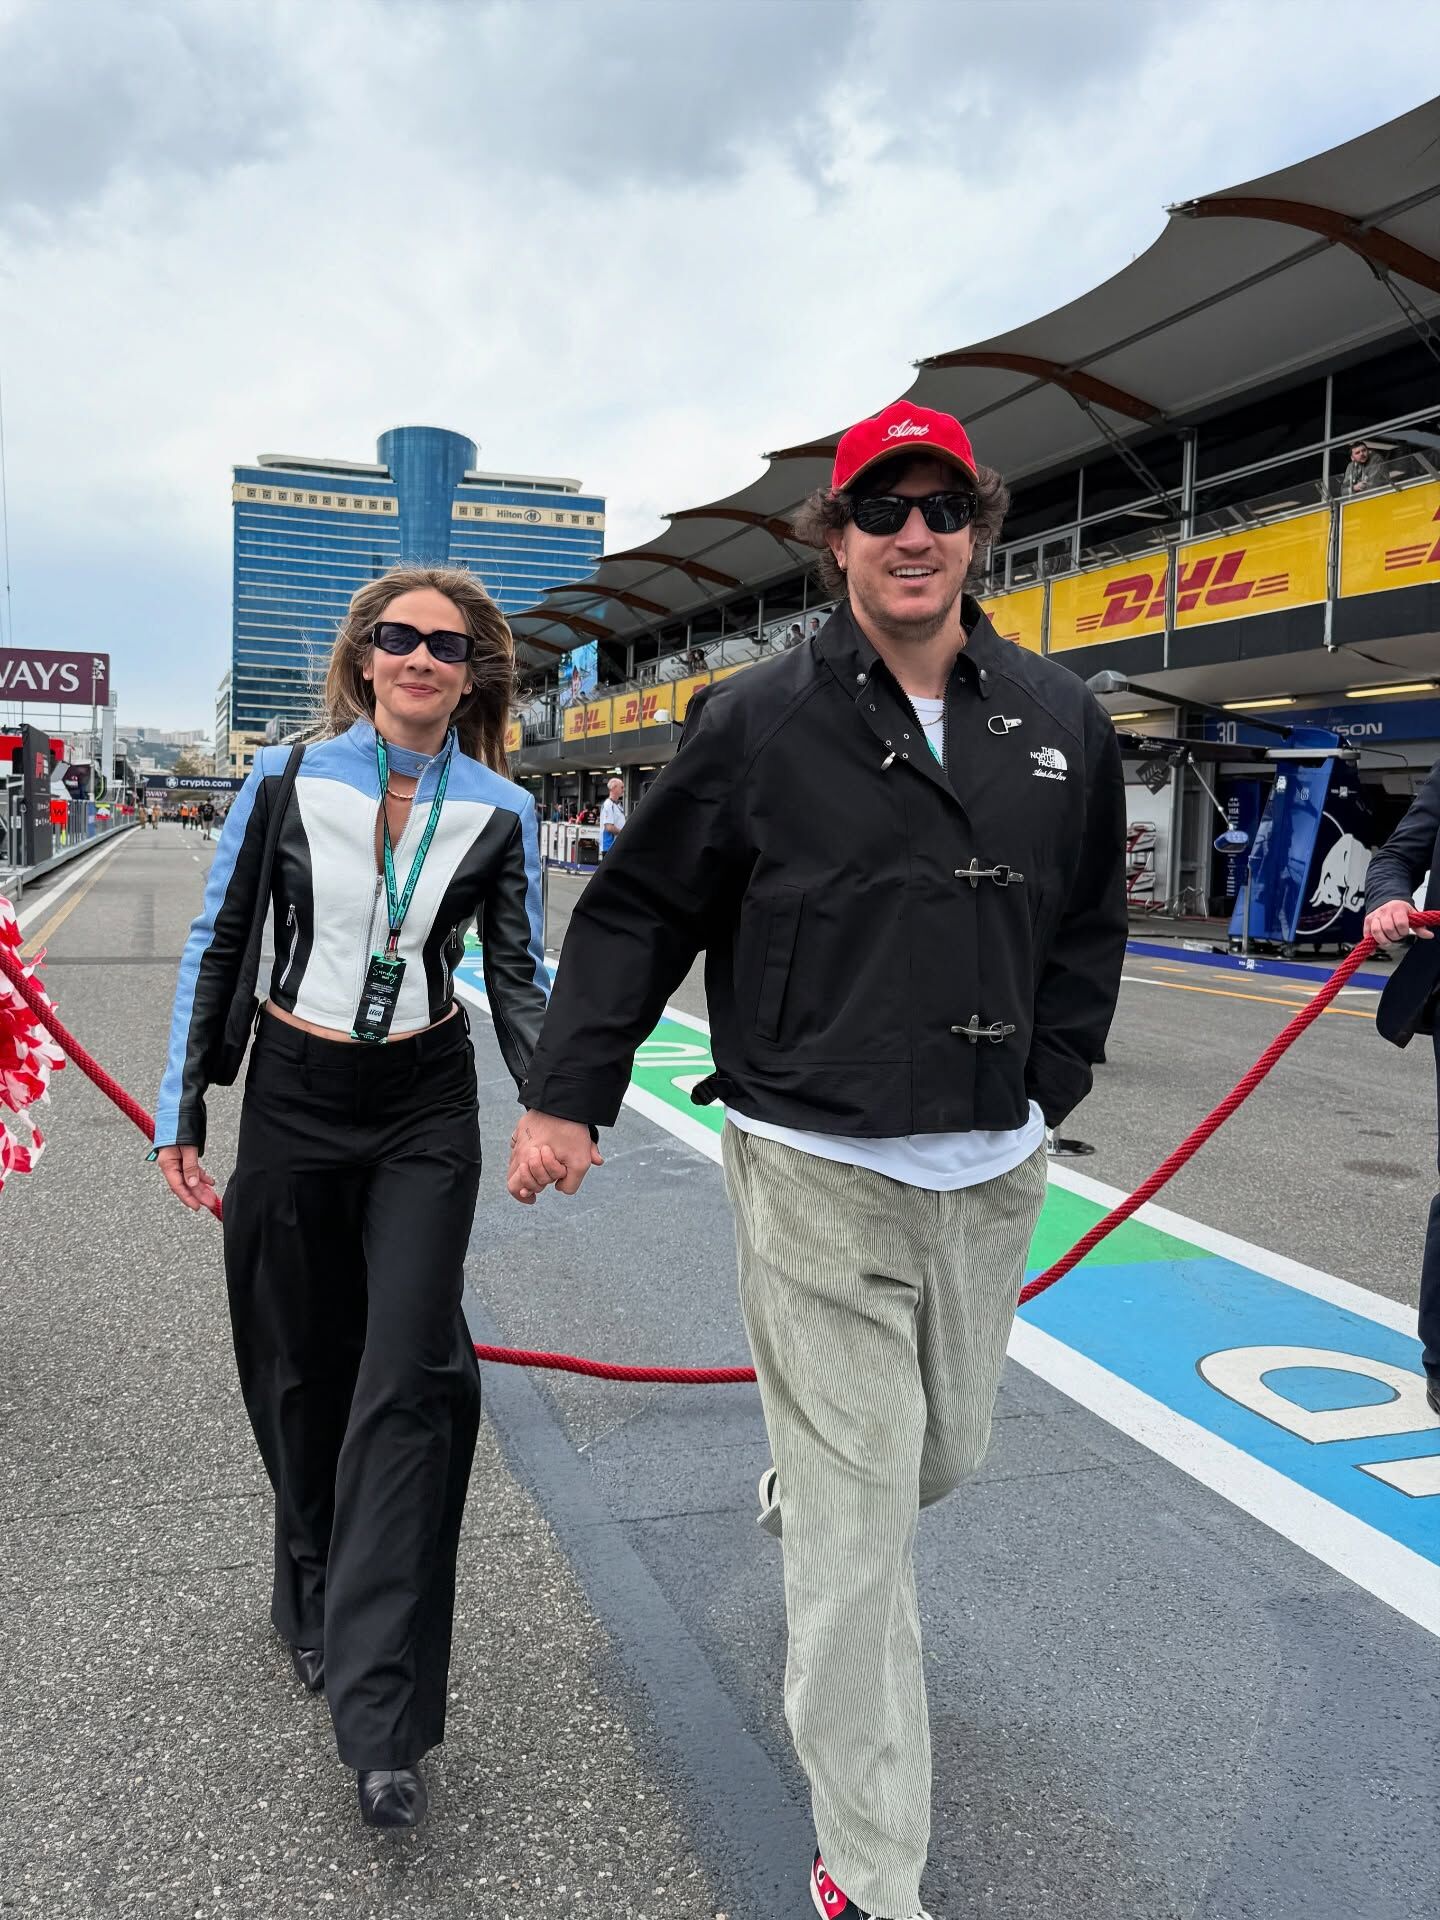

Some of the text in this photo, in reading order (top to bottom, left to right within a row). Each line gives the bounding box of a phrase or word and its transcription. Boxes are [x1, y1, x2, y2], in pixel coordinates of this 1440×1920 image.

[496, 509, 522, 519] Hilton
[1100, 549, 1256, 628] DHL
[574, 708, 600, 734] DHL
[1216, 721, 1236, 744] 30
[1041, 746, 1055, 756] THE
[1030, 751, 1055, 762] NORTH
[1038, 760, 1056, 769] FACE
[180, 779, 232, 788] crypto.com
[368, 1008, 383, 1017] LEGO
